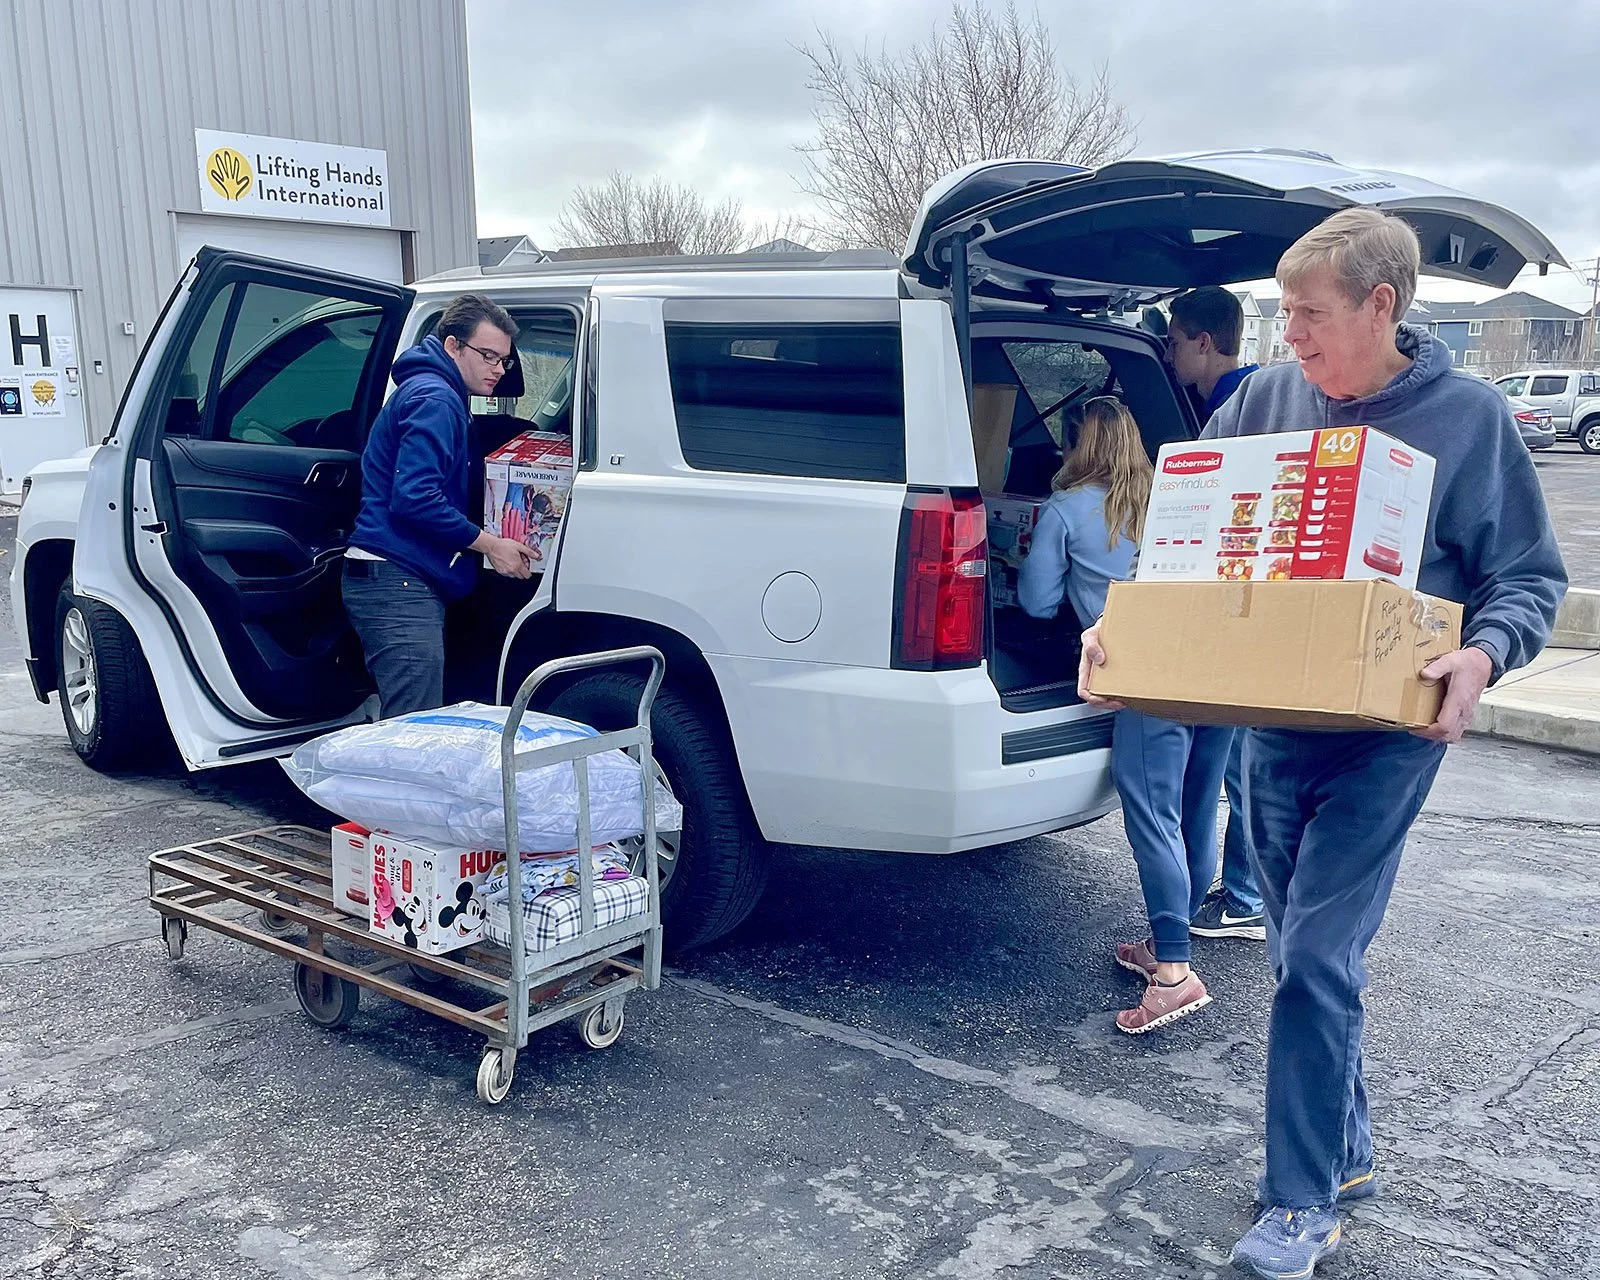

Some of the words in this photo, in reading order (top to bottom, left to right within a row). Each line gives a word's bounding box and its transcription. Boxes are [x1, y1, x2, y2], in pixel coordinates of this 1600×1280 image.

[256, 154, 321, 188] Lifting
[326, 161, 383, 187] Hands
[258, 180, 384, 211] International
[9, 314, 52, 368] H
[1322, 432, 1356, 454] 40
[1166, 458, 1220, 469] Rubbermaid
[515, 470, 559, 481] FARBERWARE
[423, 860, 433, 871] 3
